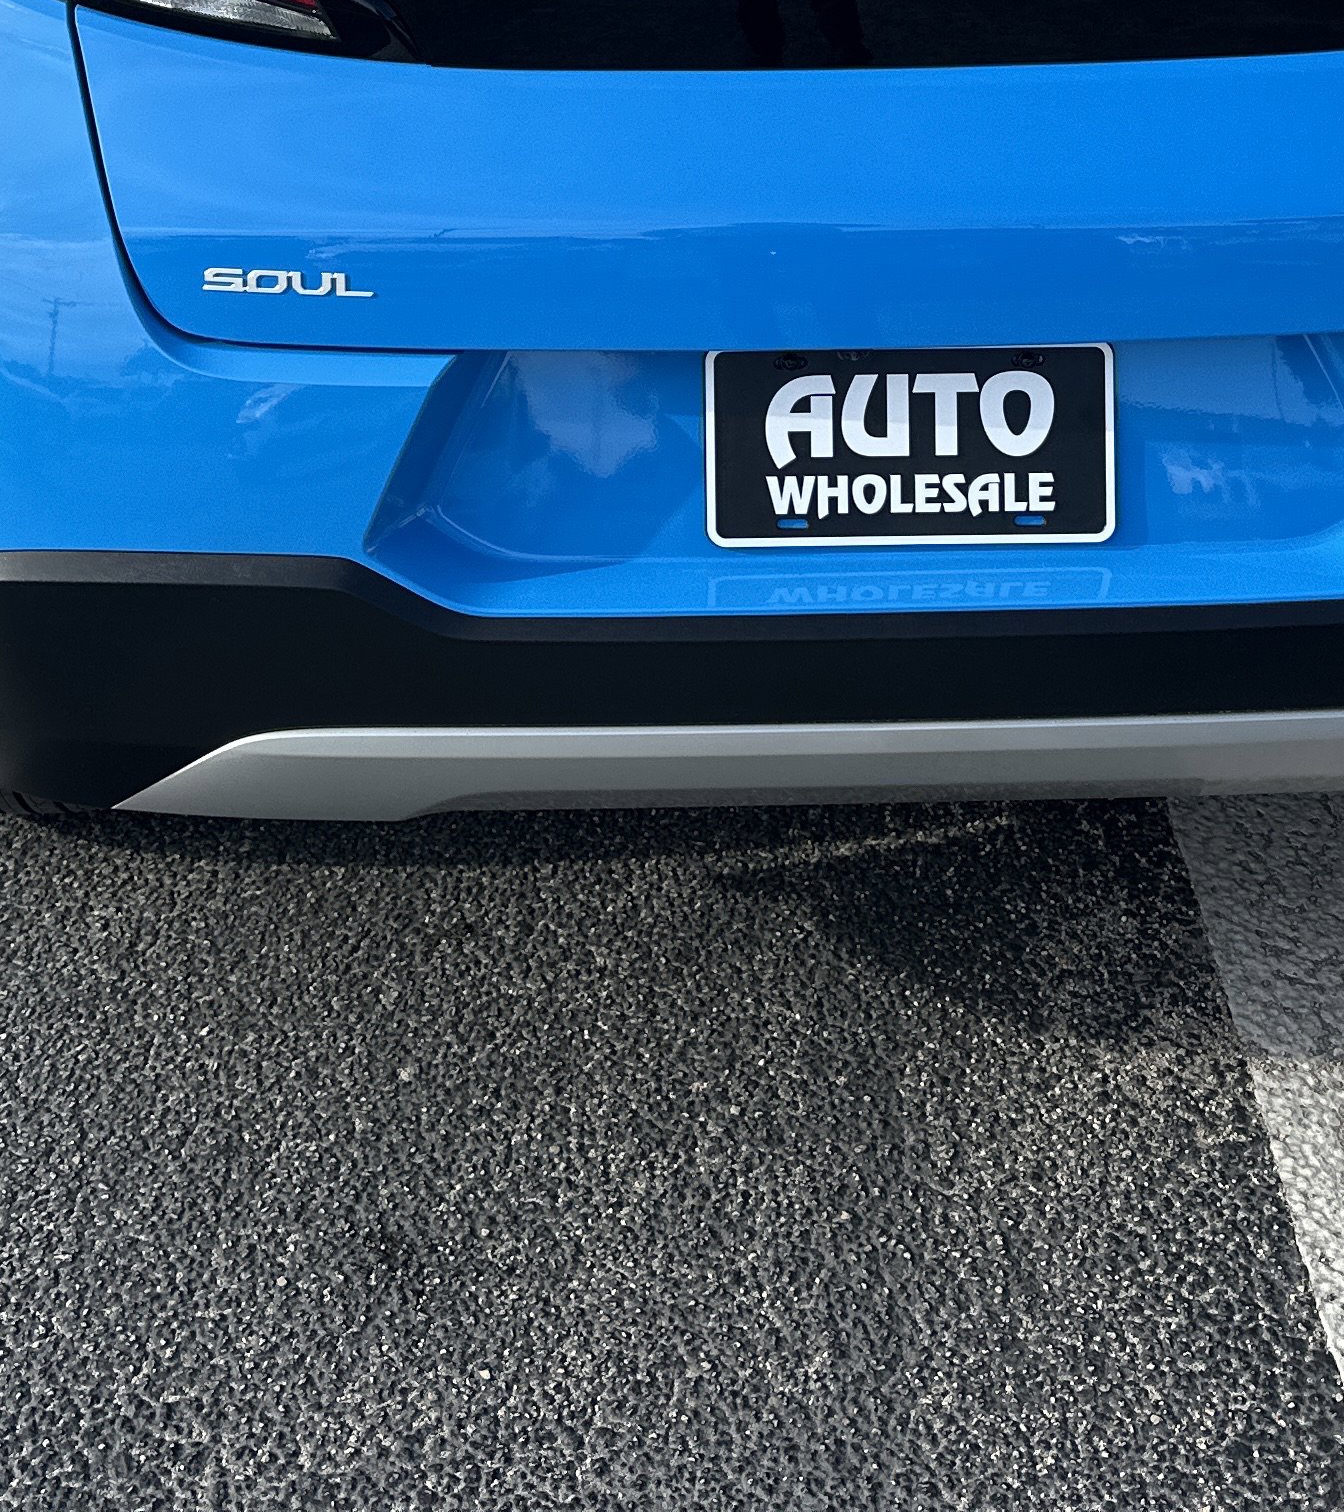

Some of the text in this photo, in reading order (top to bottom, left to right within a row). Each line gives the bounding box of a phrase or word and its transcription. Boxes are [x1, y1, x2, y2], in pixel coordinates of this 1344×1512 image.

[202, 267, 375, 298] SOUL
[765, 370, 1056, 470] AUTO
[765, 472, 1056, 520] WHOLESALE
